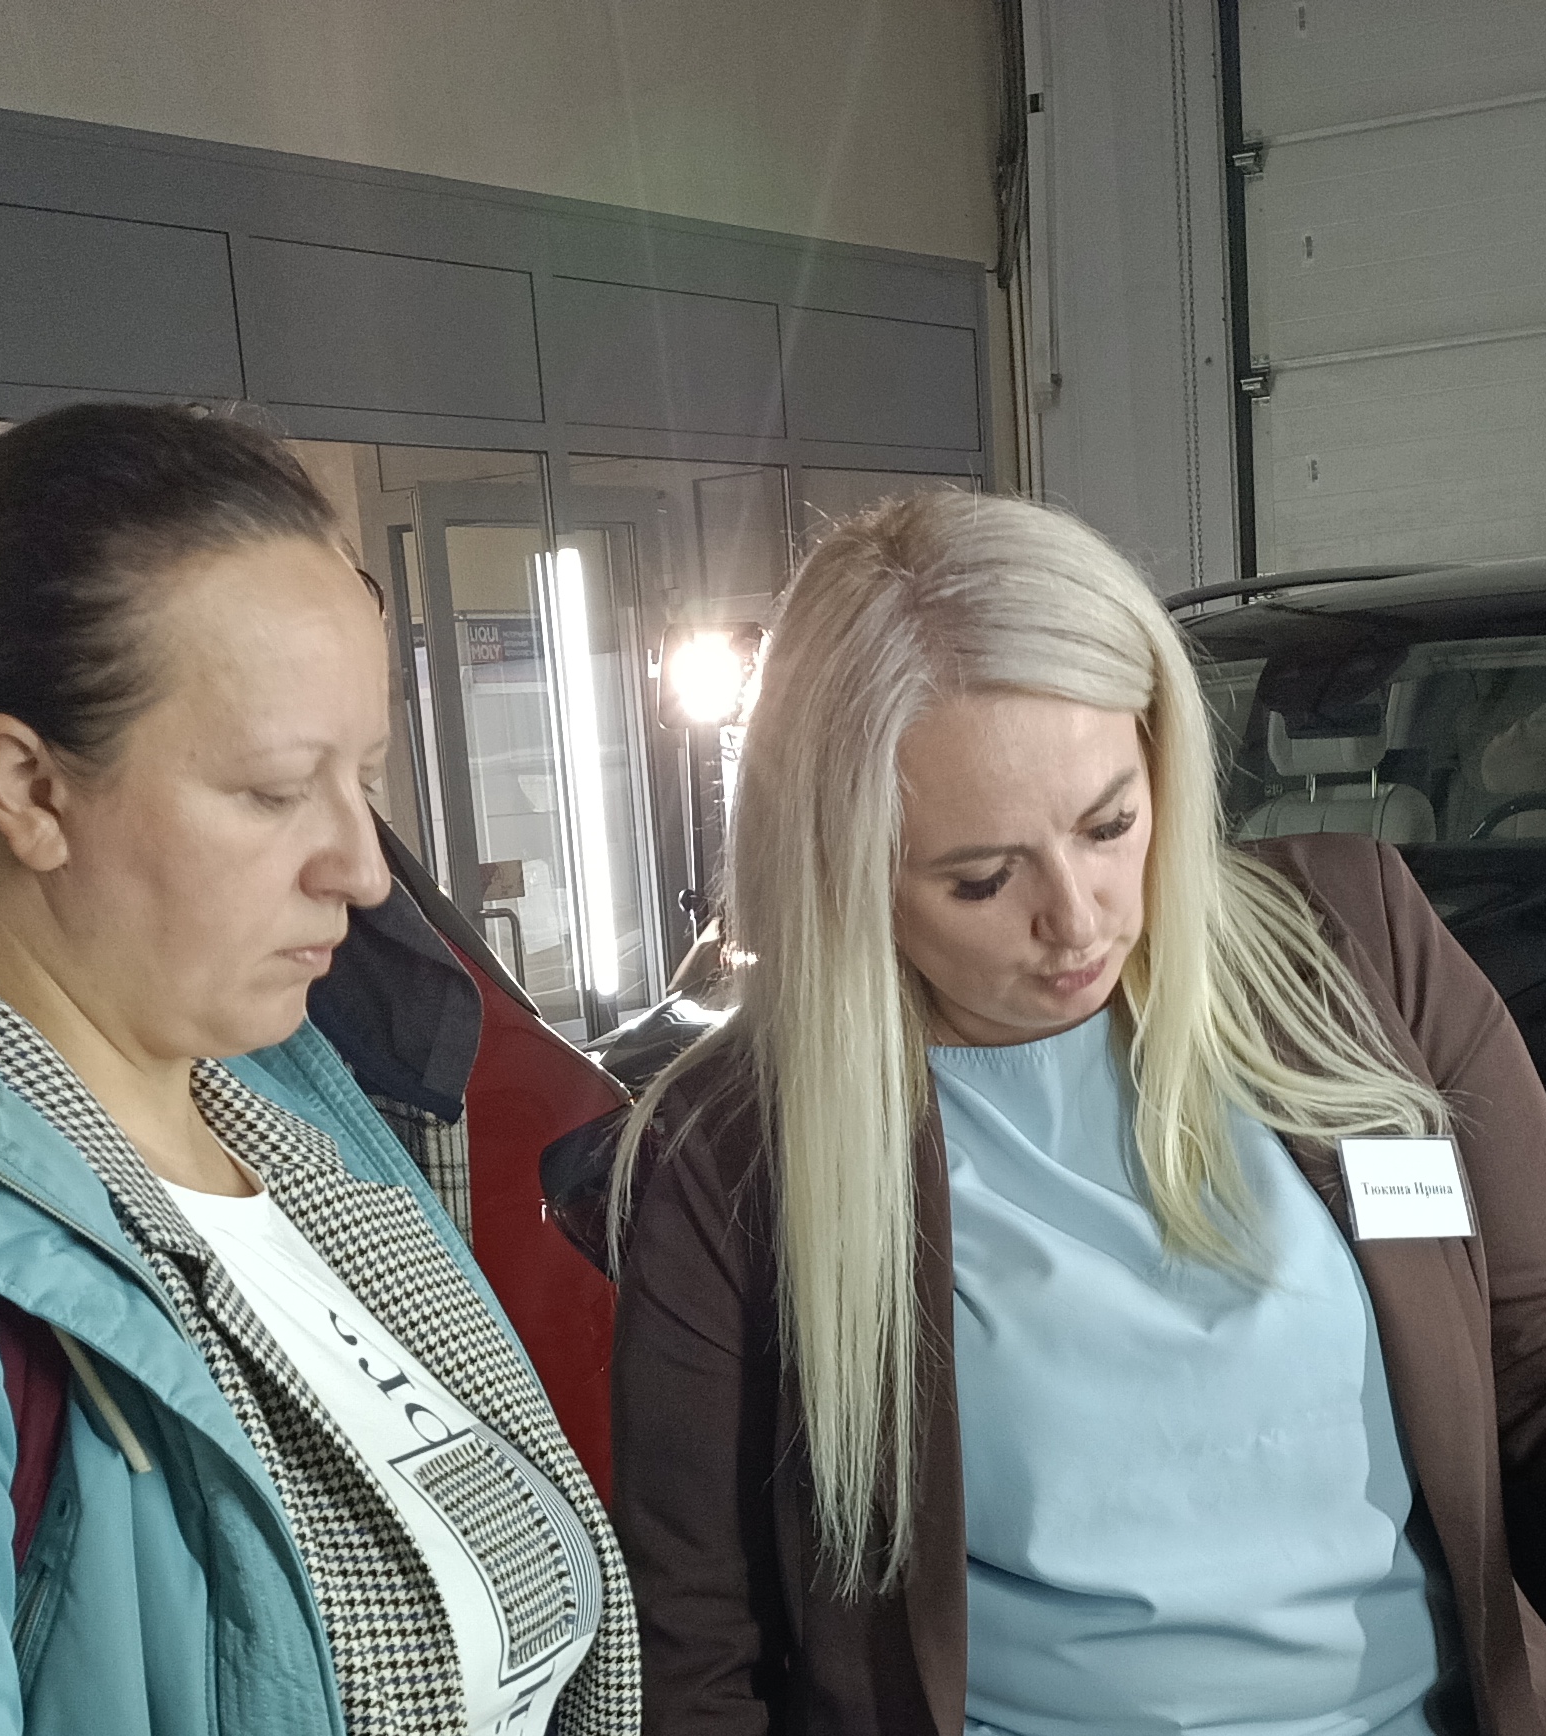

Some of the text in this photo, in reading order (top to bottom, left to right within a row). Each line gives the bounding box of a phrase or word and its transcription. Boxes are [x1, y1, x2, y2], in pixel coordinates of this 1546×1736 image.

[469, 626, 499, 642] LIQUI
[471, 644, 501, 660] MOLY
[1361, 1182, 1453, 1198] Тюкина Ирина
